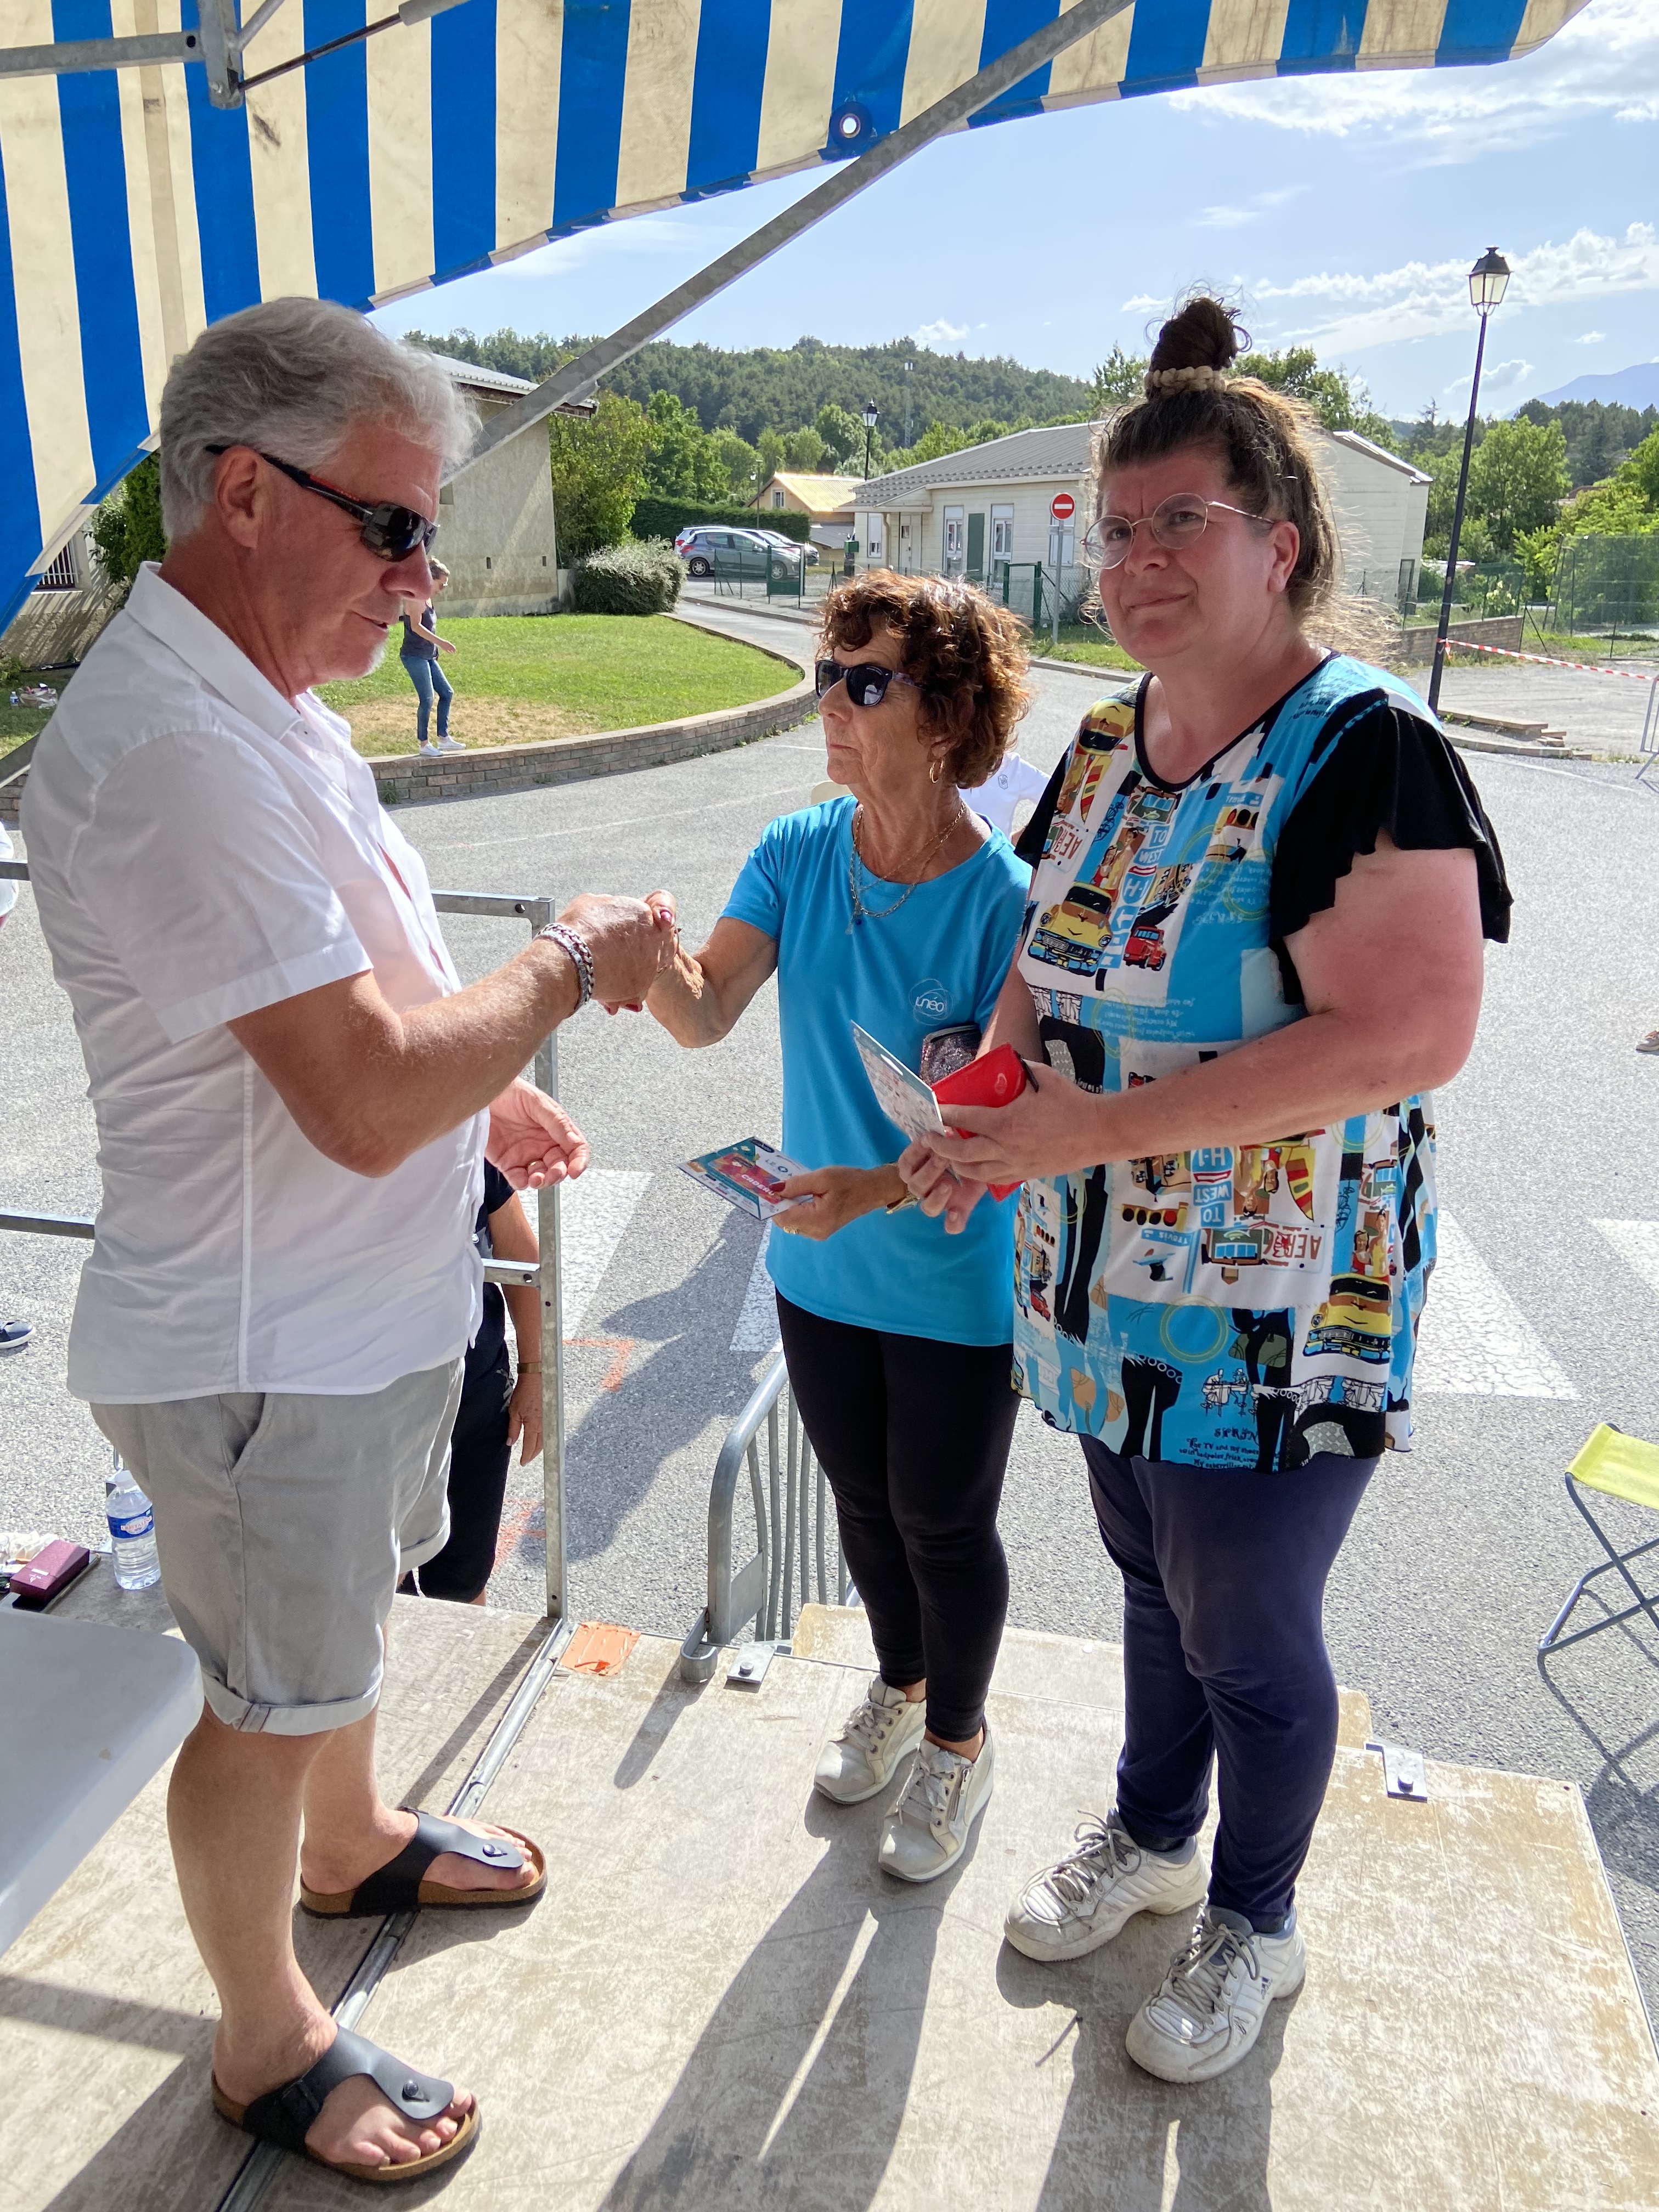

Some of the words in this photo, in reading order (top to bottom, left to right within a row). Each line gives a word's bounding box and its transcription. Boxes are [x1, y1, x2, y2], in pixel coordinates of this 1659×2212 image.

[1154, 830, 1167, 843] TO
[741, 1174, 775, 1196] CADEAU
[1194, 1184, 1230, 1203] WEST
[1203, 1207, 1222, 1223] TO
